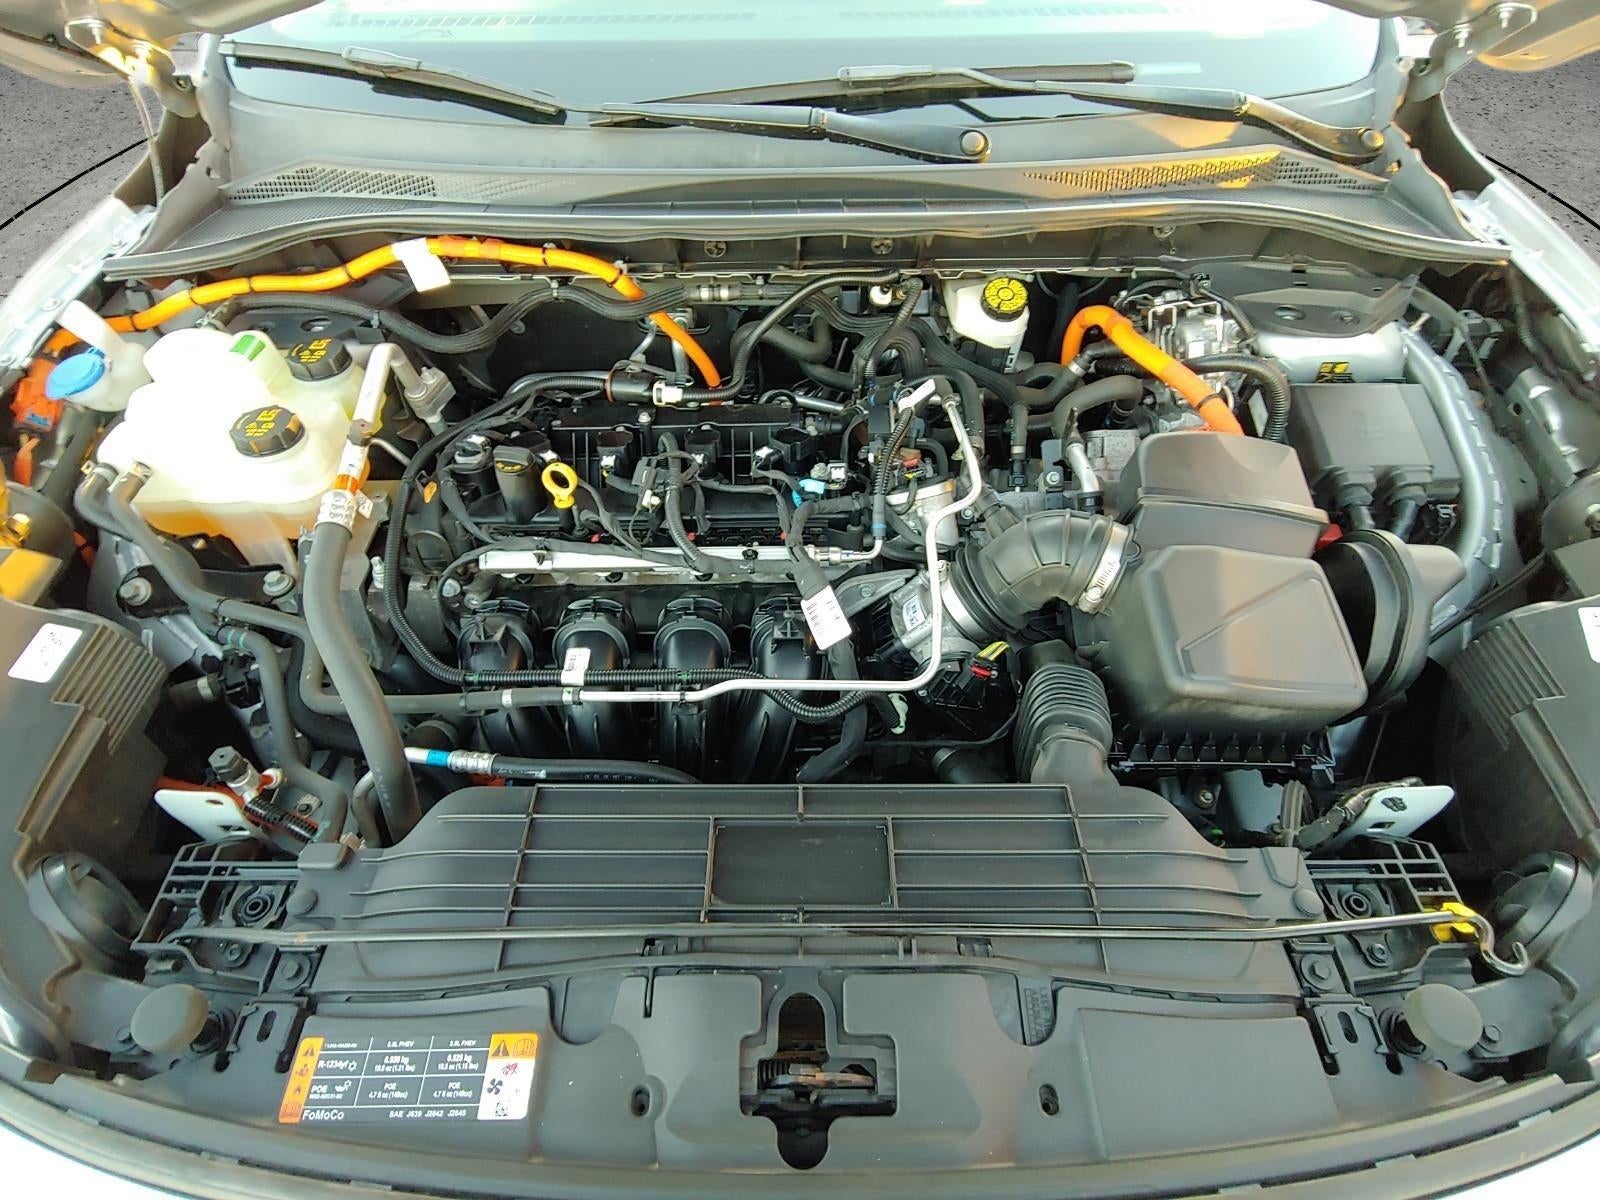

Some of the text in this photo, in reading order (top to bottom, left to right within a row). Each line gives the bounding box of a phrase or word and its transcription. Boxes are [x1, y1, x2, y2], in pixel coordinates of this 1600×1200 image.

[401, 1055, 410, 1065] kg
[464, 1053, 473, 1063] kg
[317, 1060, 348, 1071] R-1234yf
[311, 1085, 328, 1093] POE
[384, 1082, 397, 1090] POE
[448, 1081, 461, 1089] POE
[302, 1110, 345, 1120] FoMoCo
[389, 1110, 404, 1118] SAE
